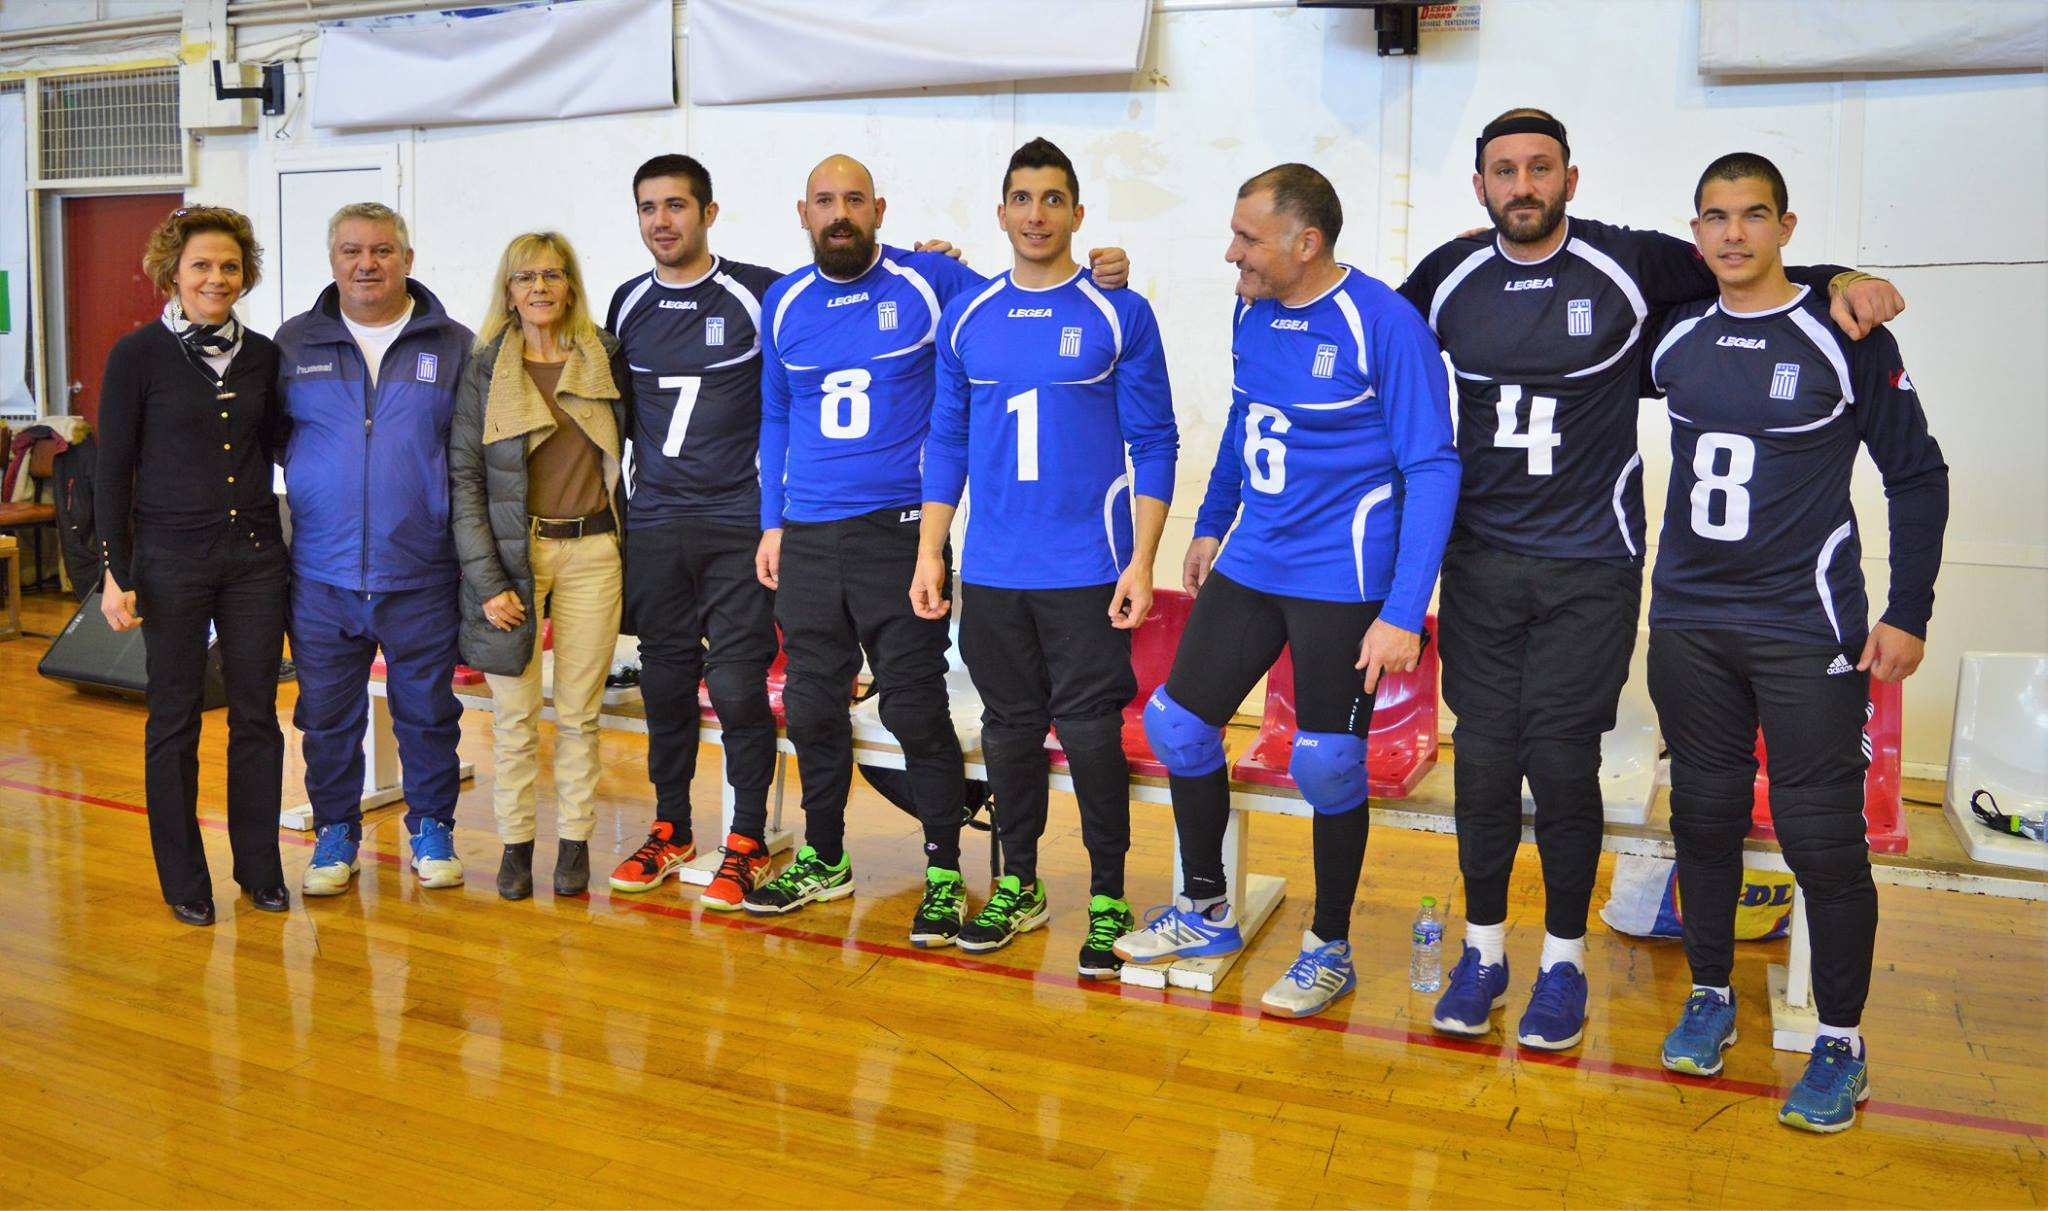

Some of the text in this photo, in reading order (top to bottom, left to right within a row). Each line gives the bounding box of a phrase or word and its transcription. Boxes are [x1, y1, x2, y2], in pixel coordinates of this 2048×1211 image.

[1504, 277, 1554, 291] LEGEA
[658, 300, 698, 310] LEGEA
[827, 292, 870, 308] LEGEA
[1007, 308, 1053, 318] LEGEA
[1271, 319, 1309, 331] LEGEA
[1715, 335, 1766, 350] LEGEA
[296, 362, 333, 375] hummel
[820, 368, 872, 439] 8
[658, 376, 702, 458] 7
[1006, 387, 1039, 482] 1
[1493, 384, 1562, 476] 4
[1243, 402, 1292, 495] 6
[1690, 431, 1755, 541] 8
[900, 510, 920, 522] LE
[1826, 664, 1854, 675] adidas
[1739, 883, 1792, 907] DL
